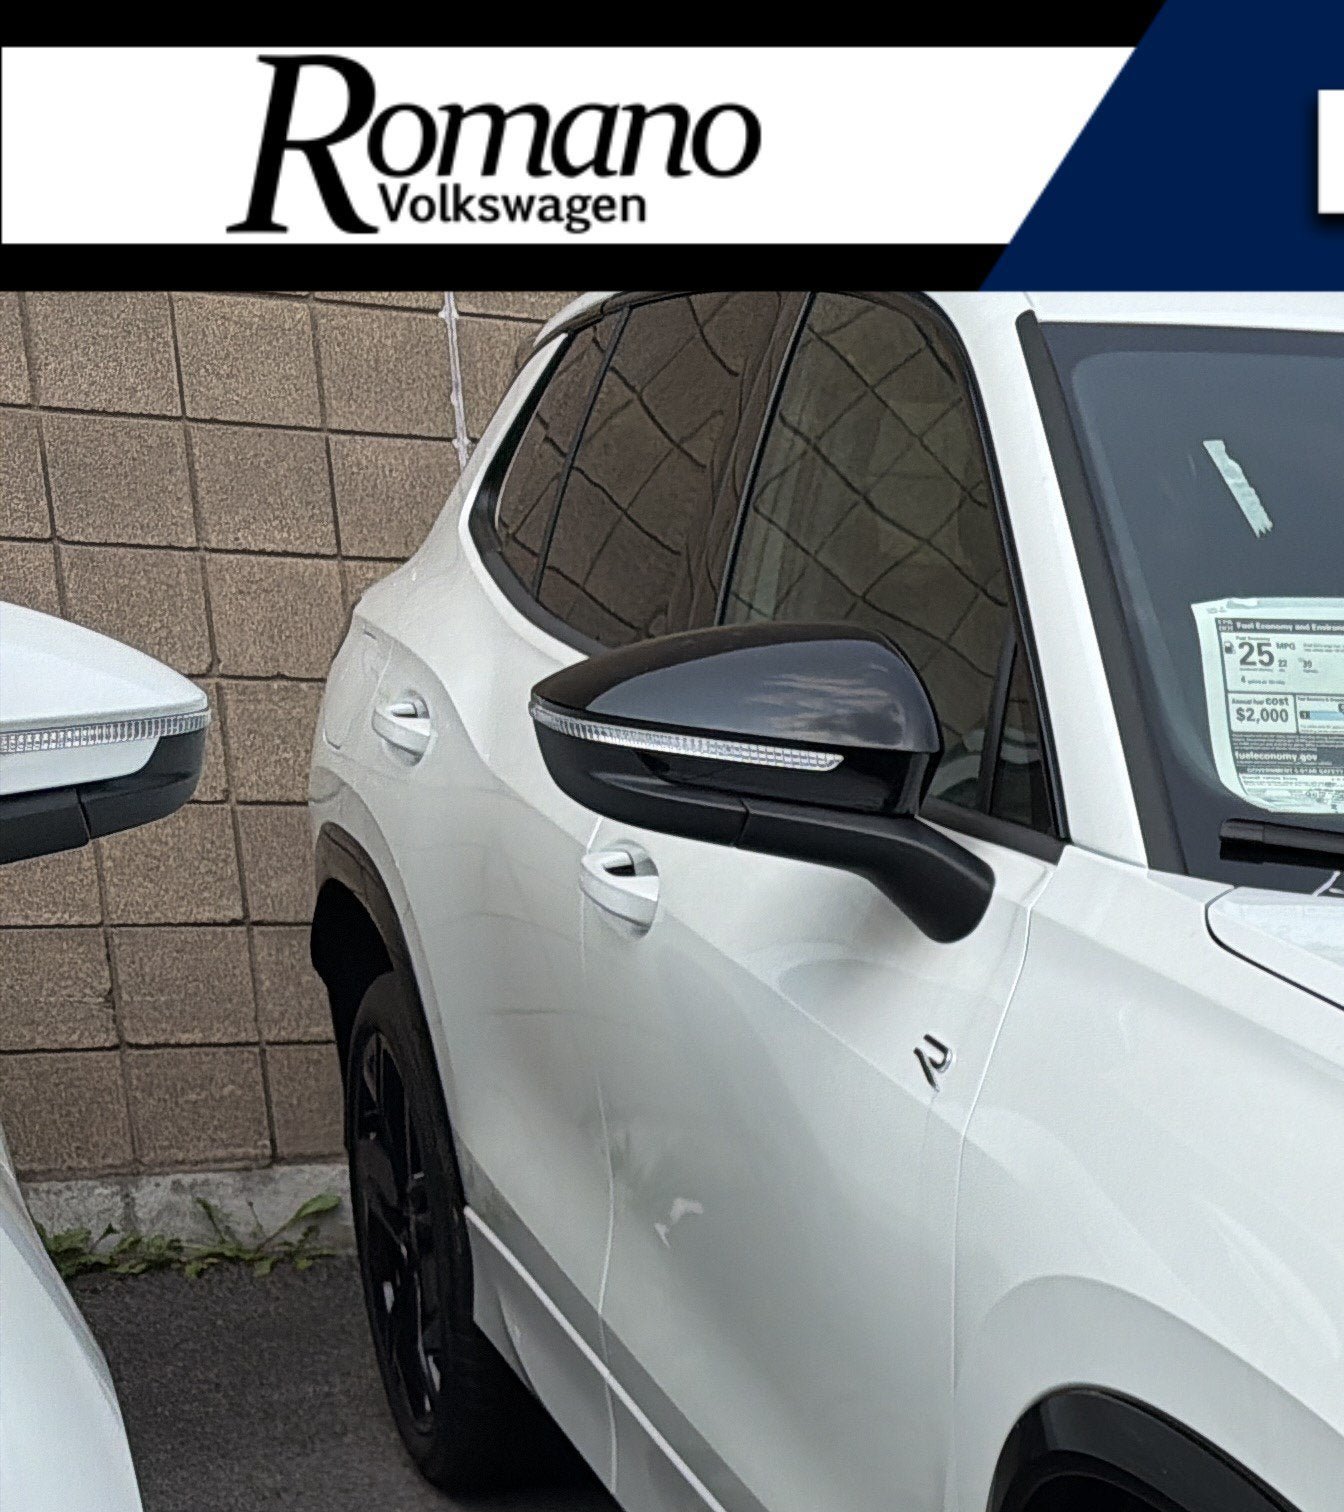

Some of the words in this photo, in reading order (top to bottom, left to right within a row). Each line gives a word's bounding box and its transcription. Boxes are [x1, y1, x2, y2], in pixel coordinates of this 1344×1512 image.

[1236, 621, 1255, 630] Fuel
[1255, 621, 1294, 631] Economy
[1295, 623, 1311, 631] and
[1238, 641, 1275, 667] 25
[1276, 642, 1296, 651] MPG
[1265, 697, 1290, 706] cost
[1236, 706, 1289, 724] $2,000
[1235, 751, 1318, 762] fueleconomy.gov
